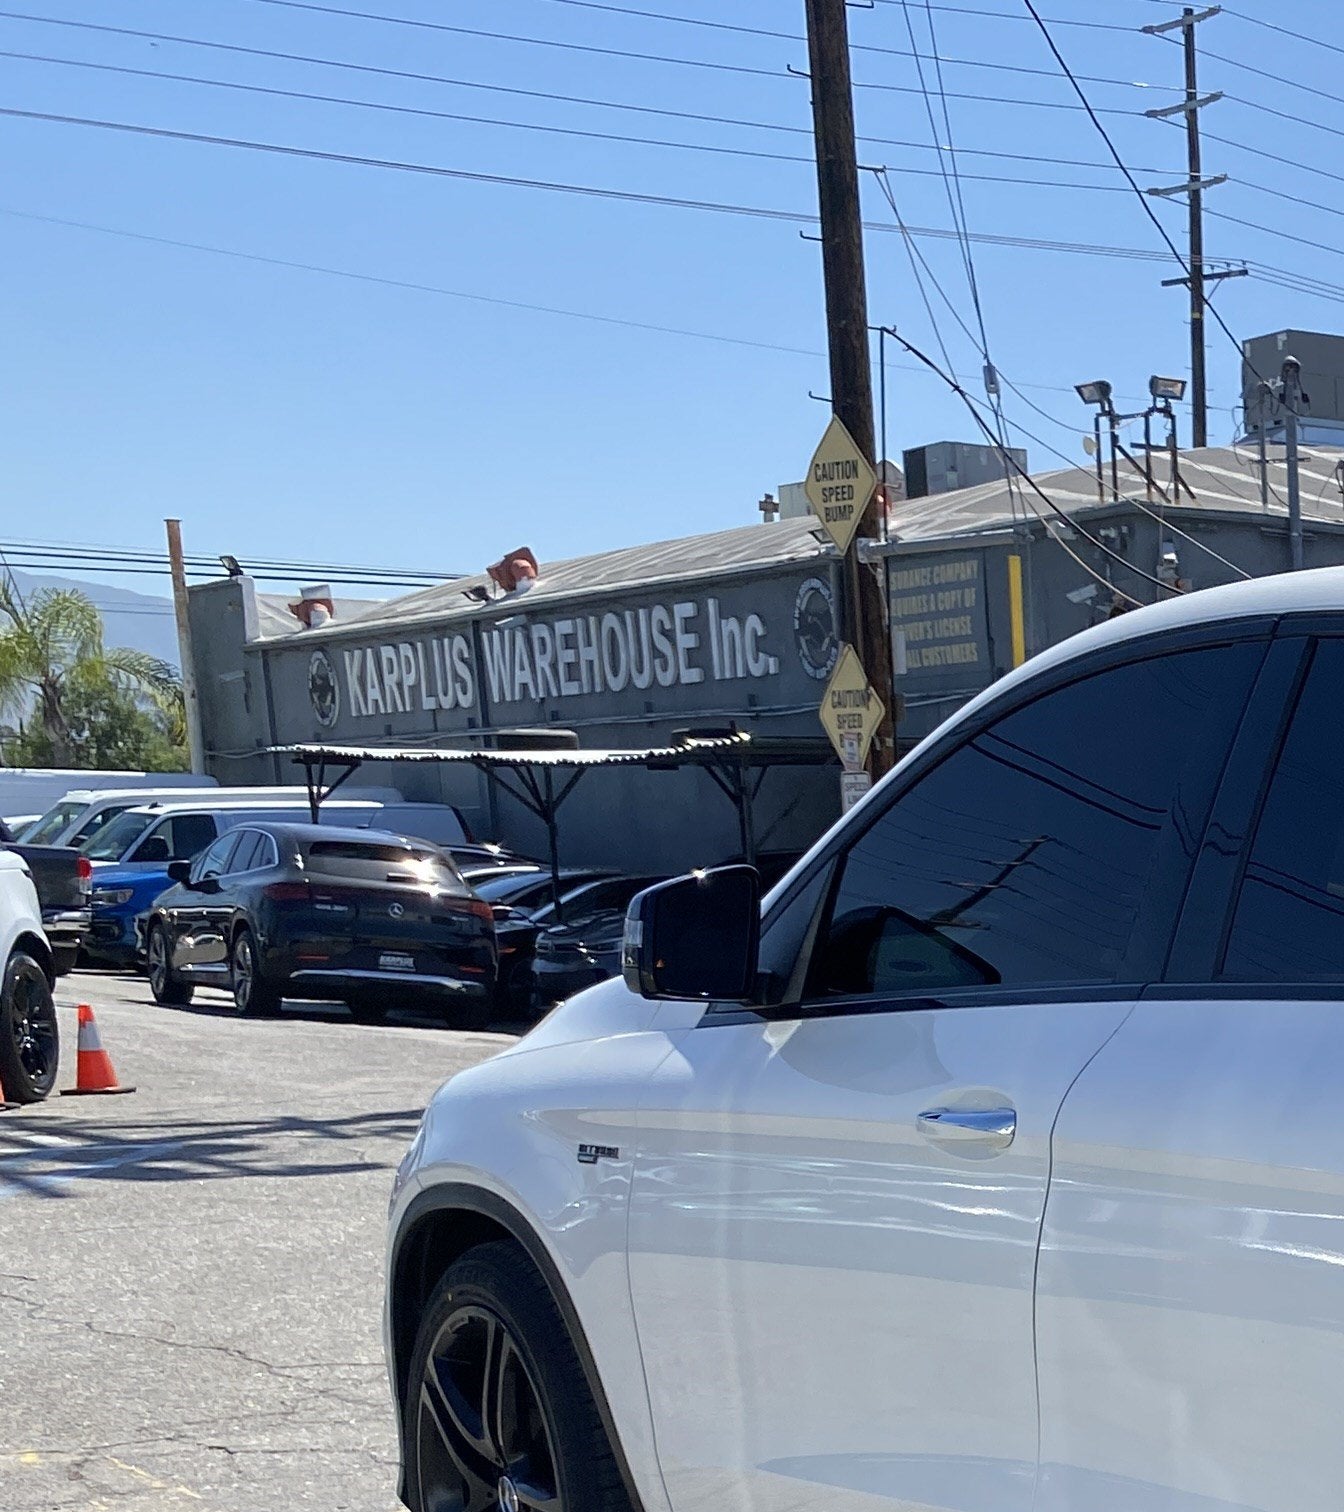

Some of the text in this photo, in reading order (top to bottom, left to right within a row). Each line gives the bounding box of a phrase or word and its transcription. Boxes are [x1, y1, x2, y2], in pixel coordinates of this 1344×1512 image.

[814, 459, 859, 482] CAUTION
[821, 484, 854, 503] SPEED
[825, 504, 854, 523] BUMP
[890, 567, 932, 592] SURANCE
[344, 598, 779, 717] KARPLUS WAREHOUSE Inc.
[832, 689, 870, 710] CAUTION
[837, 713, 863, 729] SPEED
